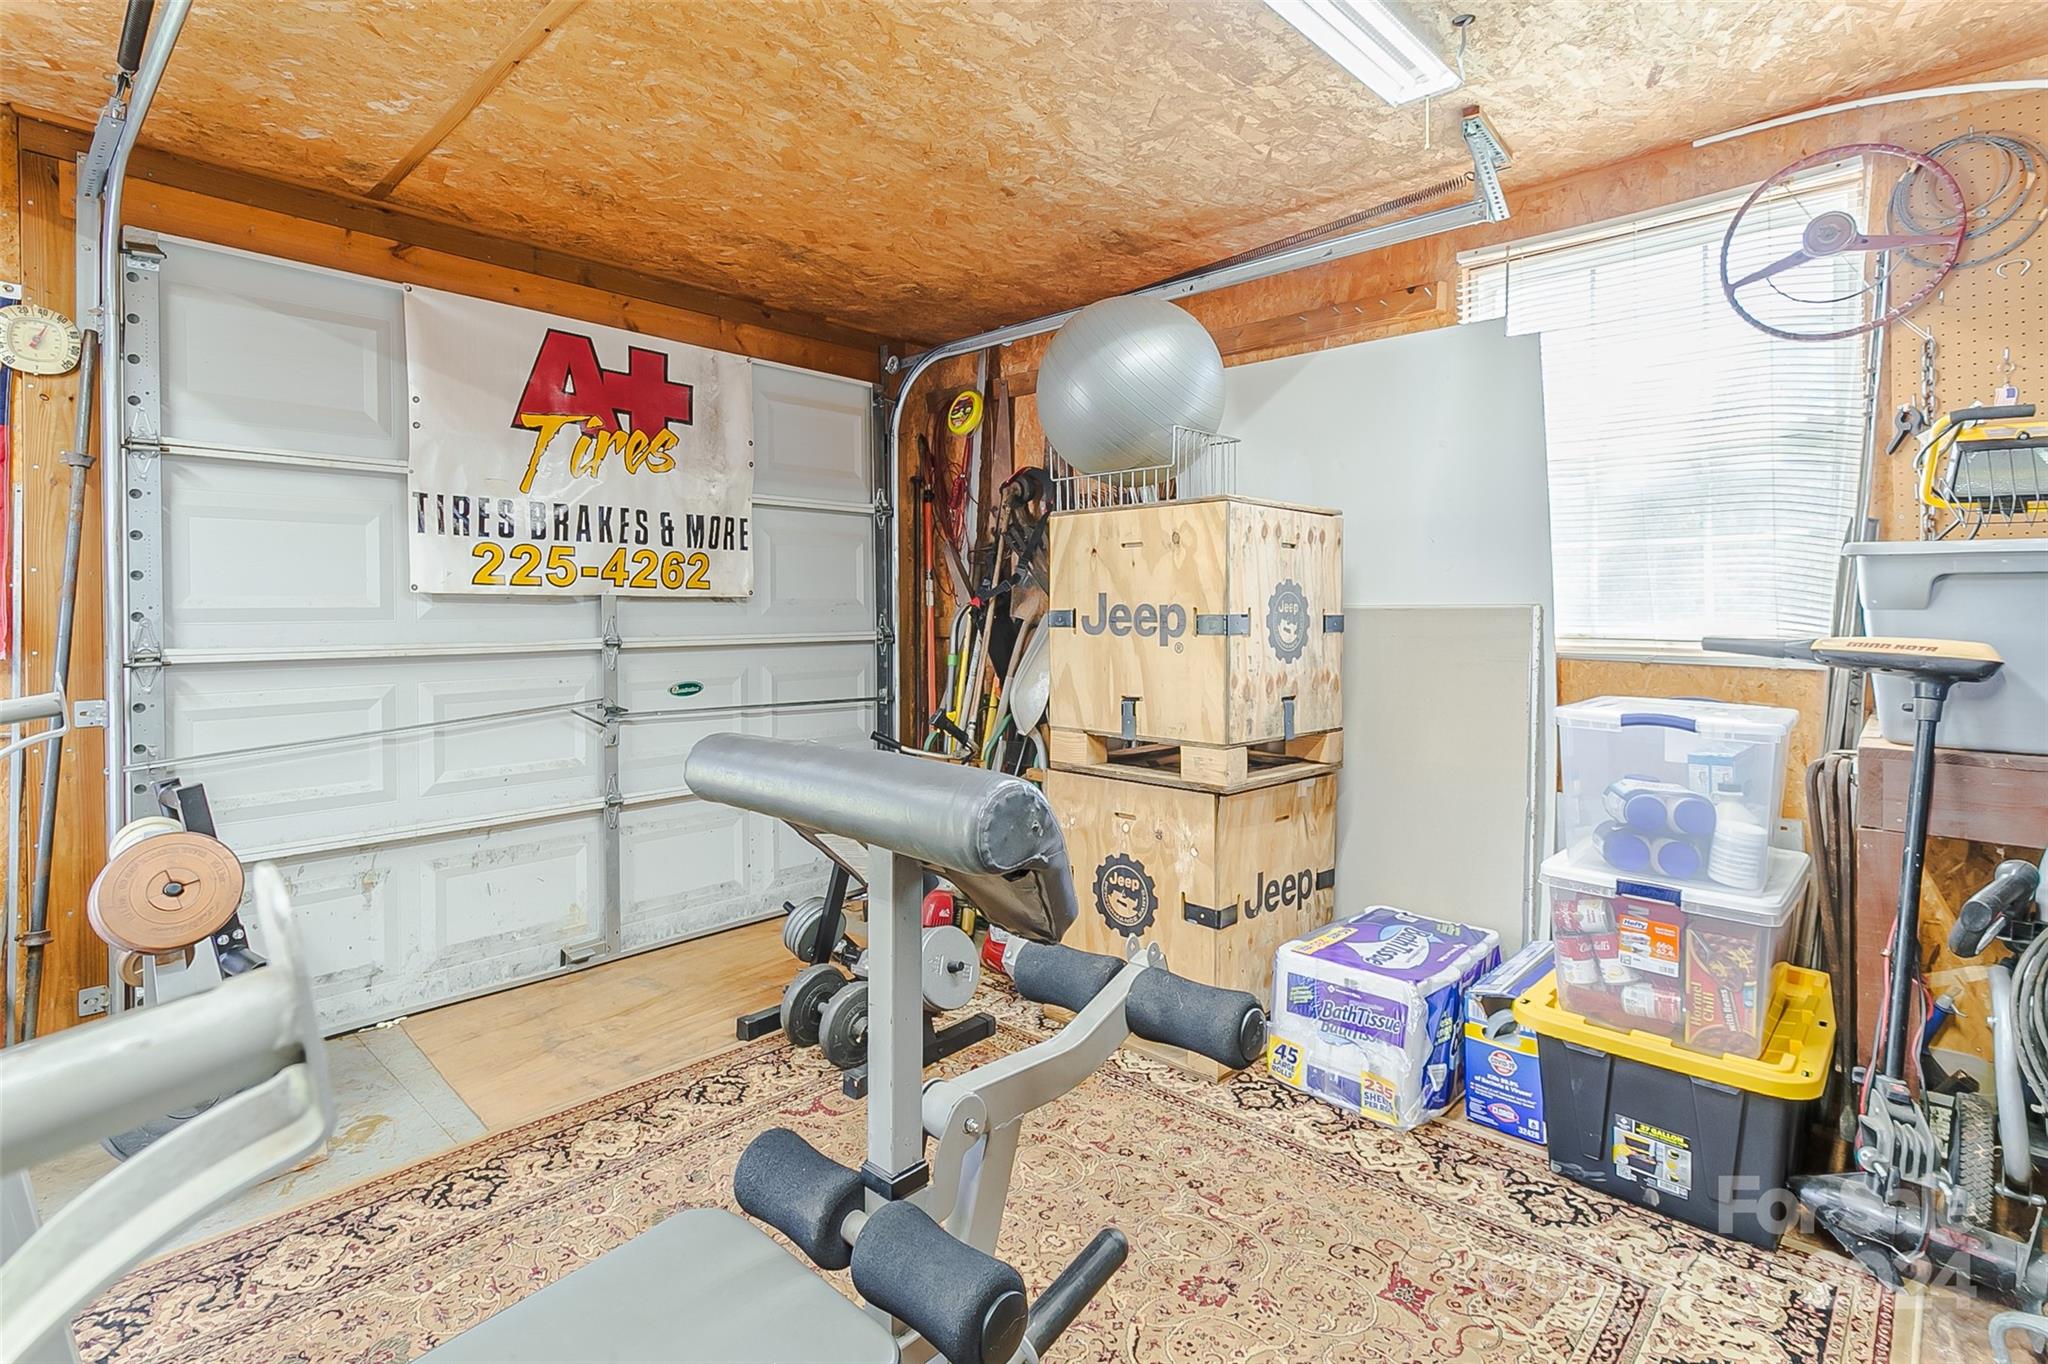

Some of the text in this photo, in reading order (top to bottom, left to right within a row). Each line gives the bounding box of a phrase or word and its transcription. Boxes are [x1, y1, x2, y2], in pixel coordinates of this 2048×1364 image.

[17, 306, 29, 314] 20
[37, 308, 49, 317] 40
[56, 314, 68, 324] 60
[510, 327, 694, 437] A+
[519, 412, 680, 494] Tires
[412, 491, 750, 552] TIRES BRAKES & MORE
[471, 542, 711, 590] 225-4262
[1279, 600, 1299, 616] Jeep
[1081, 592, 1186, 647] Jeep
[1109, 871, 1140, 892] Jeep
[1244, 868, 1313, 920] Jeep
[1624, 919, 1646, 929] Hefty
[1703, 991, 1715, 1021] Chili
[1275, 1043, 1299, 1064] 45
[1271, 1064, 1293, 1079] ROLLS
[1273, 1057, 1295, 1073] LARGE
[1364, 1078, 1393, 1100] 235
